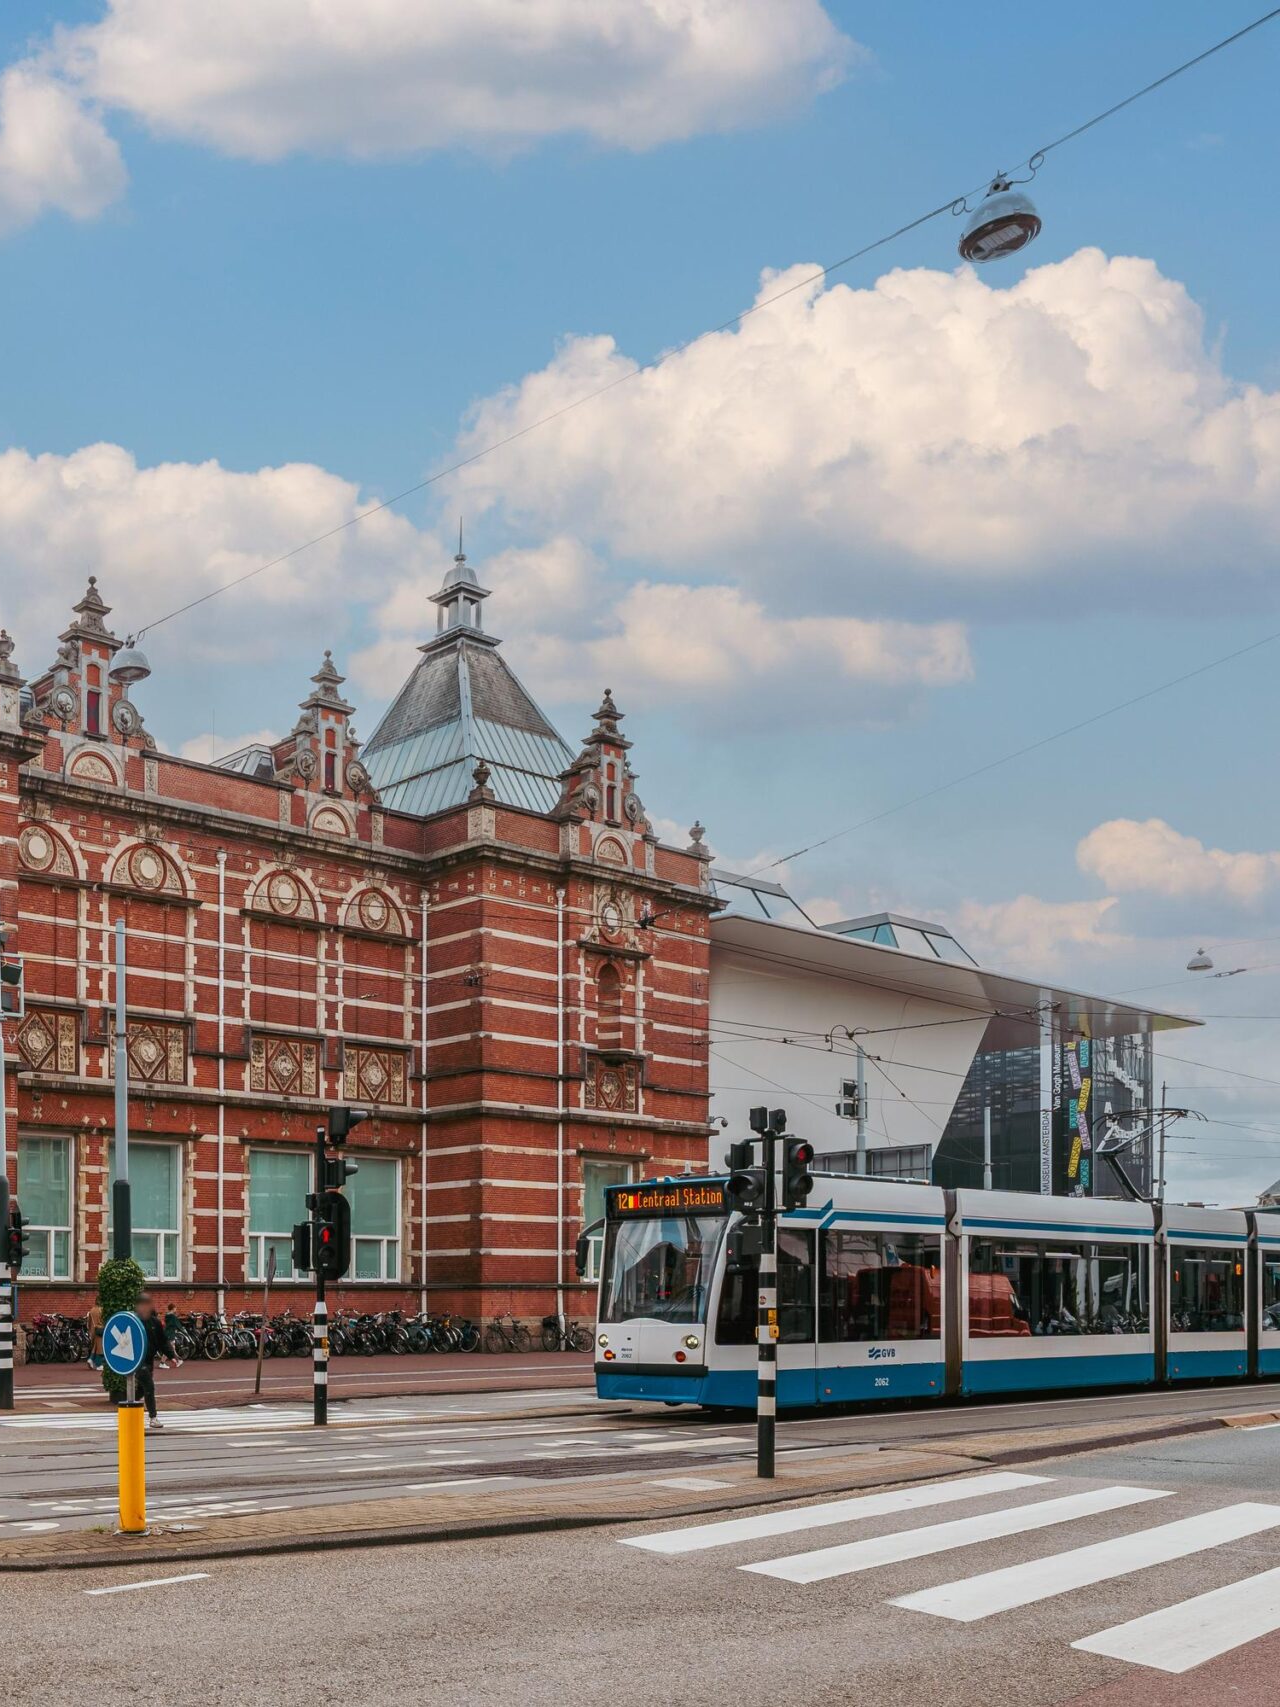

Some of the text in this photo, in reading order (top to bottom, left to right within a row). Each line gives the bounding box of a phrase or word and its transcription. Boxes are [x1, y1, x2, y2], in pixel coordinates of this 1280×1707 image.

[1053, 1043, 1062, 1110] Van Gogh Museum
[1042, 1157, 1050, 1192] MUSEUM
[618, 1187, 722, 1209] 12 Centraal Station
[881, 1348, 896, 1358] GVB
[874, 1377, 889, 1387] 2062
